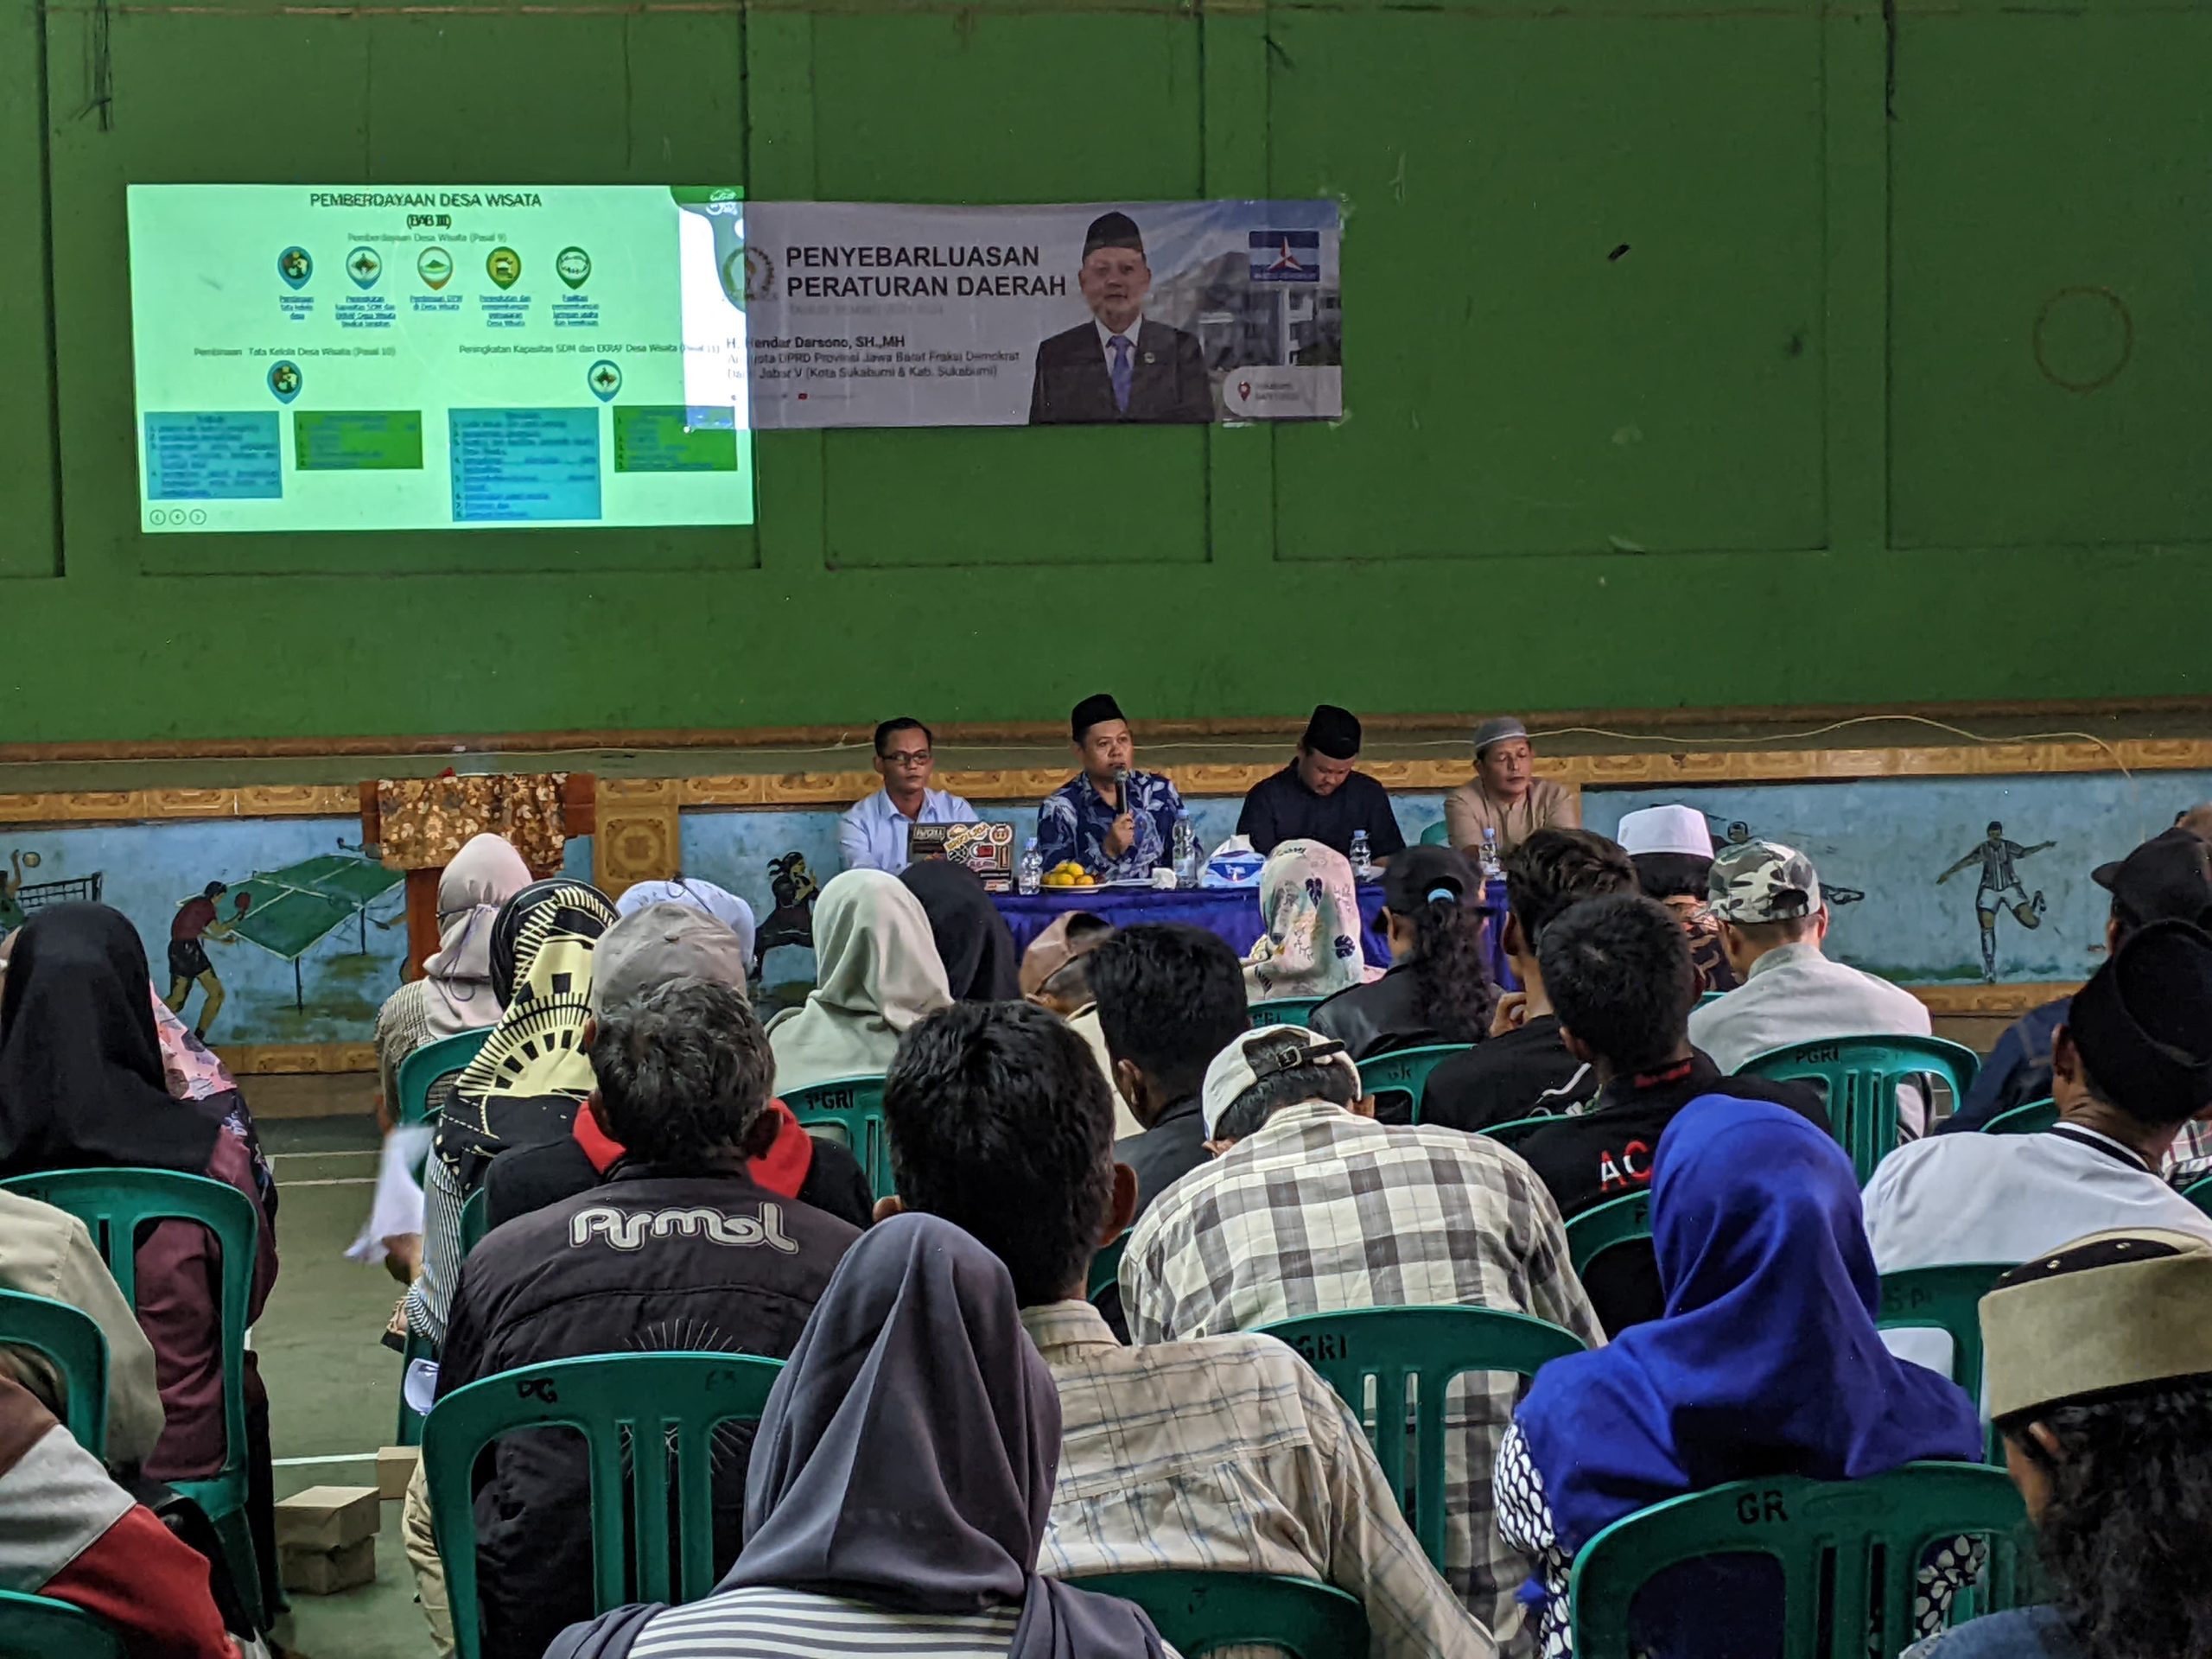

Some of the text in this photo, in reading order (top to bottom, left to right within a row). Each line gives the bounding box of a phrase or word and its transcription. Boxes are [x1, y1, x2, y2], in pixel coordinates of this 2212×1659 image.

[309, 193, 543, 207] PEMBERDAYAAN DESA WISATA
[785, 245, 1040, 268] PENYEBARLUASAN
[787, 276, 1066, 298] PERATURAN DAERAH
[795, 336, 852, 350] Darsono,
[805, 368, 837, 380] (Kota
[839, 367, 895, 378] Sukabumi
